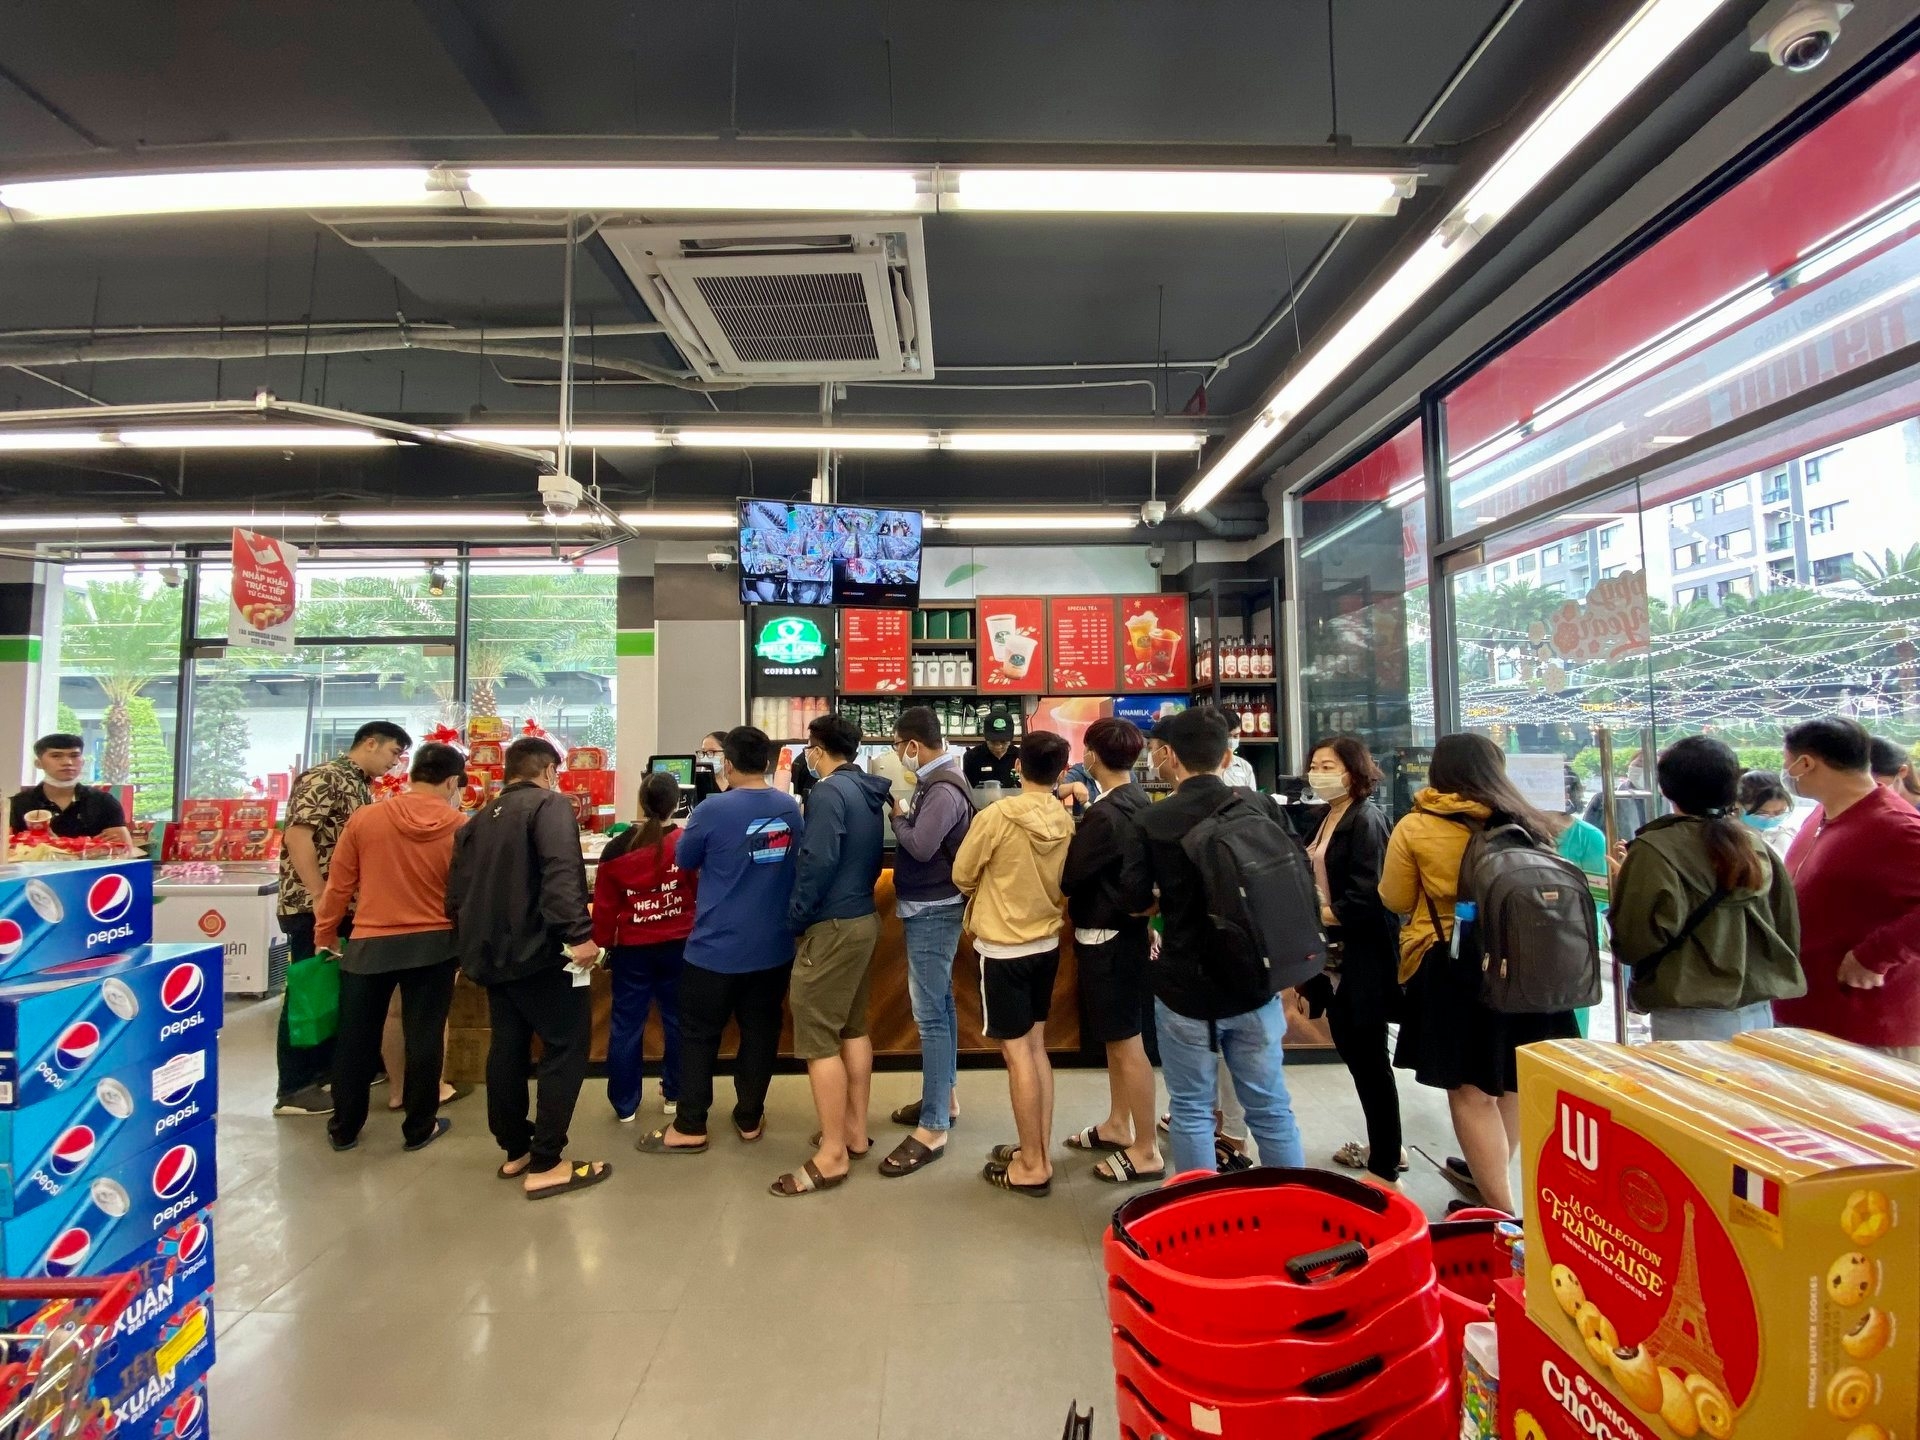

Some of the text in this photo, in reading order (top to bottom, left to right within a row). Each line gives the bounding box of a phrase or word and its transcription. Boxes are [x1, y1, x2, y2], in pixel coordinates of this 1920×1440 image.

[268, 584, 286, 596] TIẾP
[764, 667, 817, 675] COFFEE & TEA
[661, 879, 678, 892] ME
[634, 899, 660, 911] HEN
[87, 922, 132, 949] pepsi
[160, 1011, 203, 1042] pepsi
[35, 1061, 67, 1090] pepsi
[155, 1101, 198, 1136] pepsi
[1561, 1102, 1598, 1171] LU
[31, 1169, 62, 1197] pepsi
[153, 1191, 197, 1230] pepsi
[1569, 1194, 1582, 1218] LA
[182, 1255, 207, 1282] pepsi
[1561, 1232, 1647, 1301] FRENCH BUTTER COOKIES
[1808, 1275, 1818, 1409] FRENCH BUTTER COOKIES
[1590, 1391, 1643, 1440] ORION
